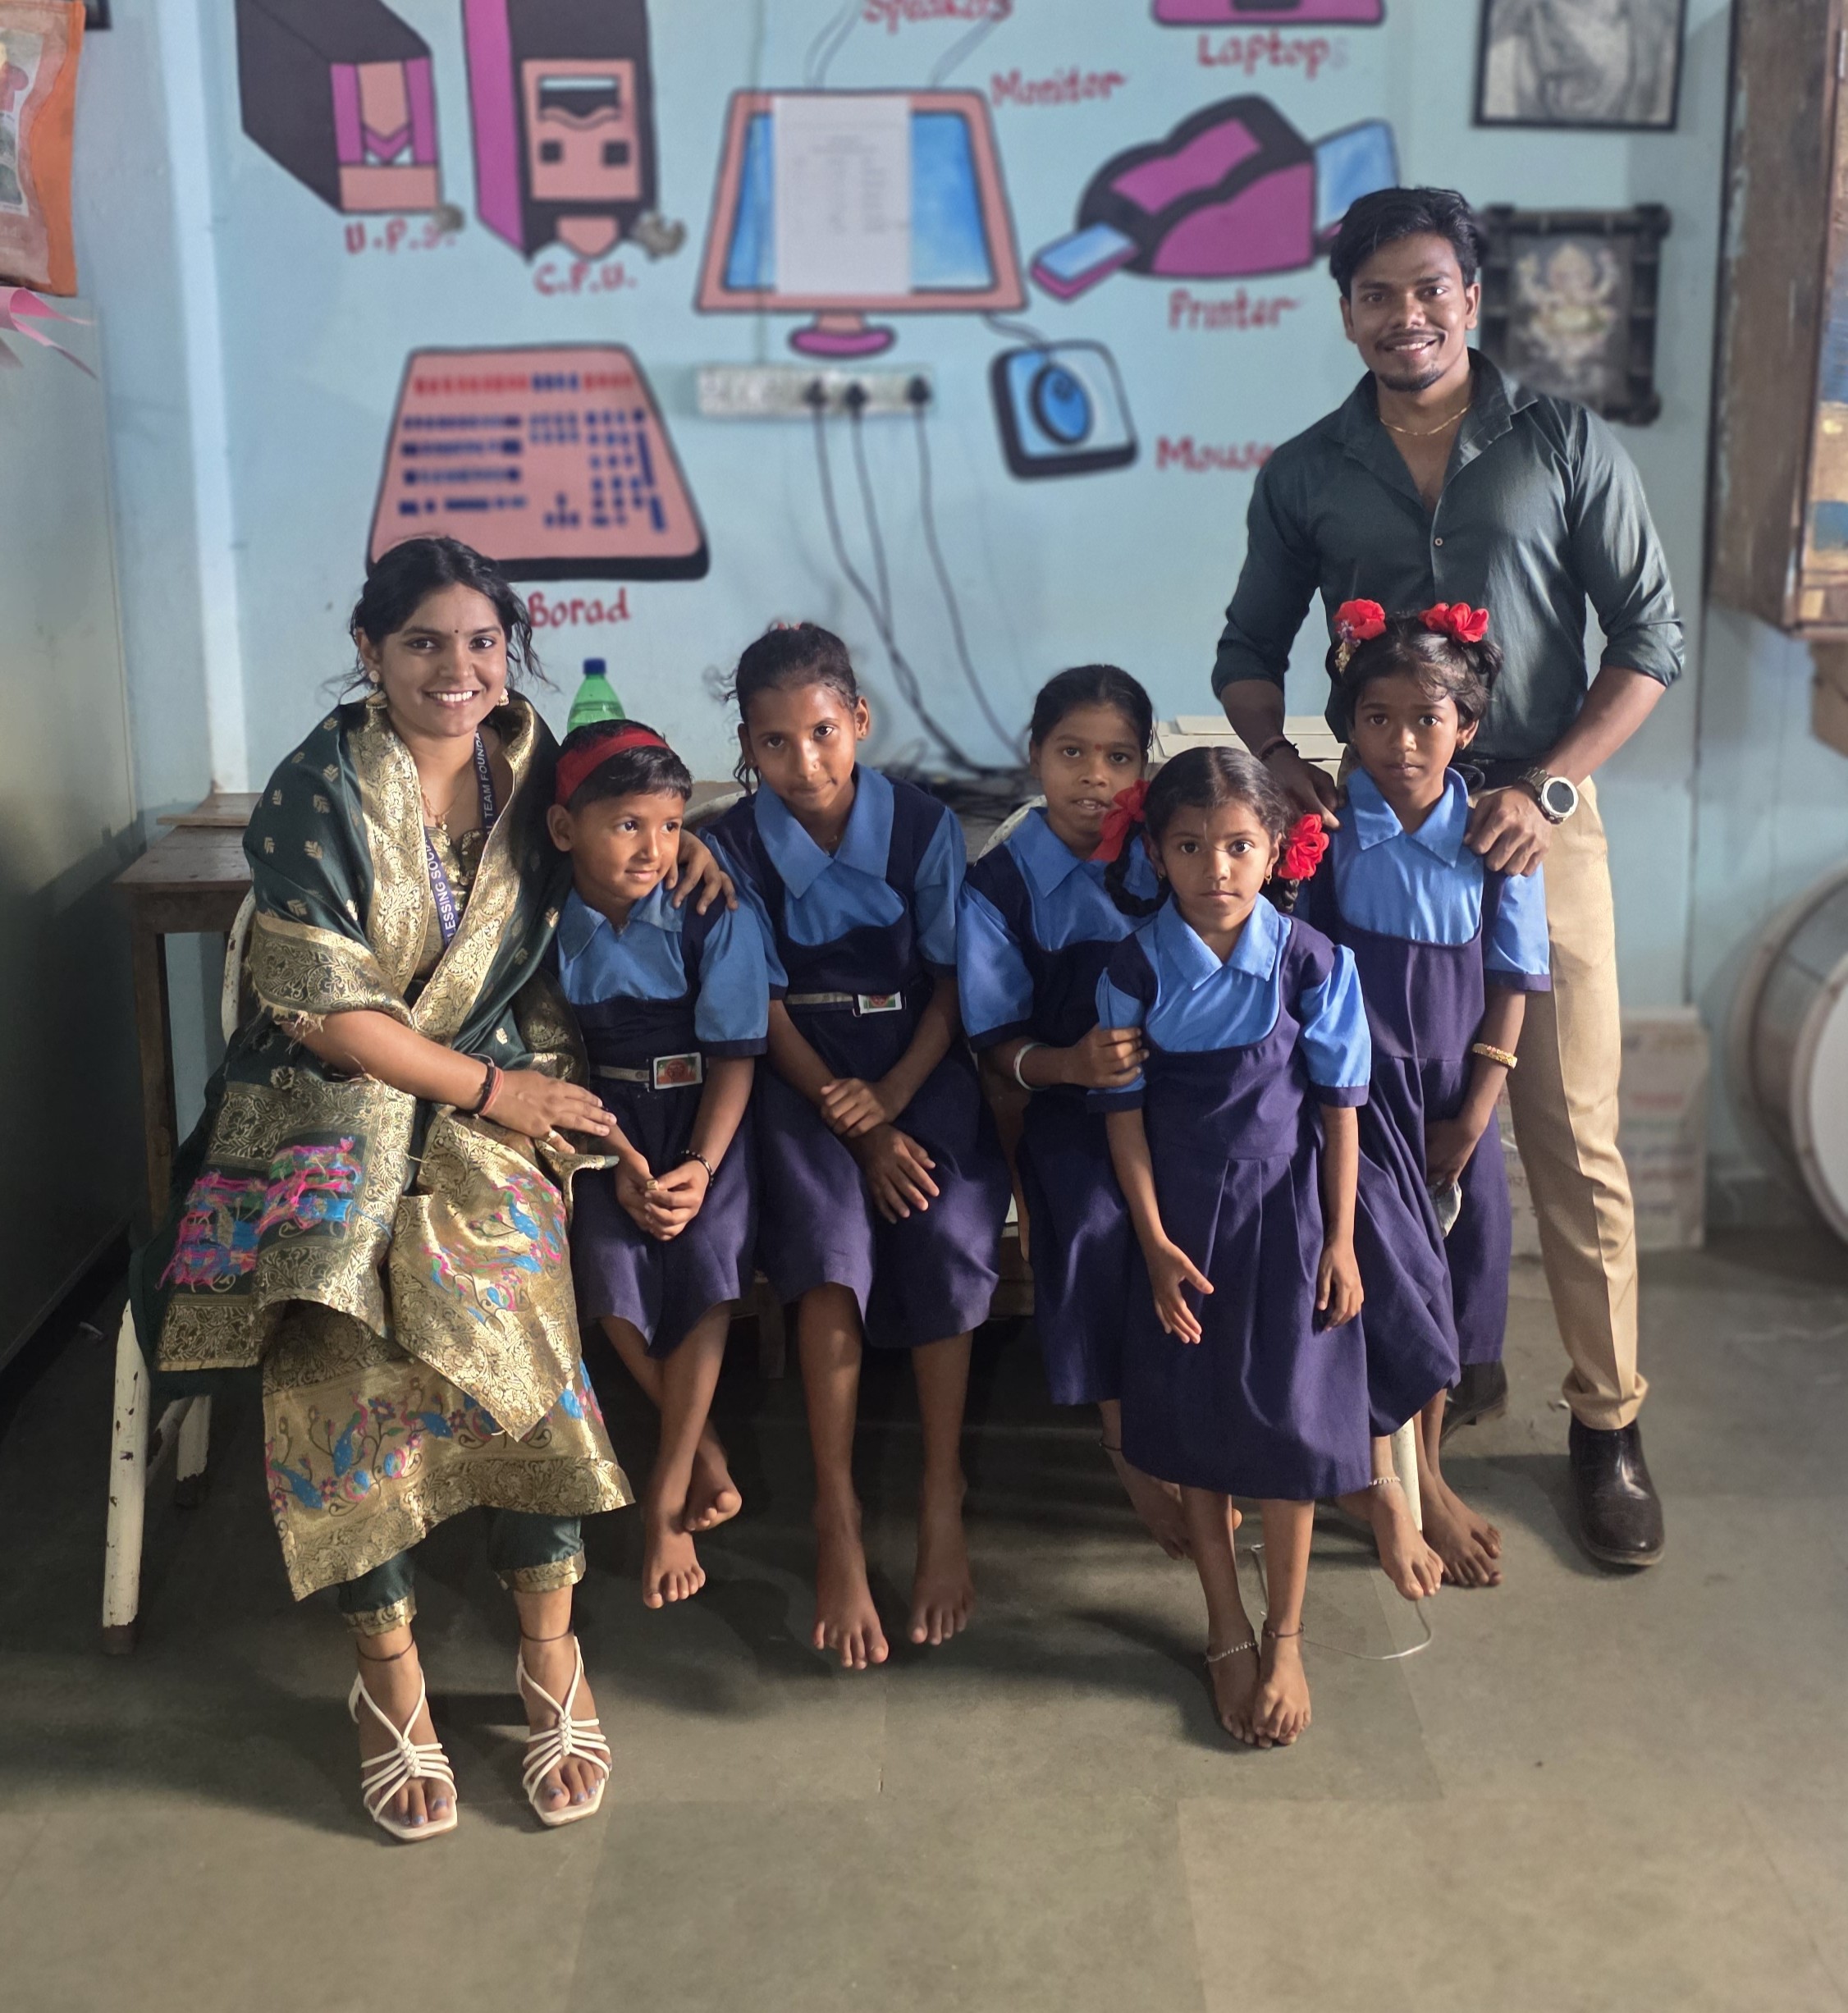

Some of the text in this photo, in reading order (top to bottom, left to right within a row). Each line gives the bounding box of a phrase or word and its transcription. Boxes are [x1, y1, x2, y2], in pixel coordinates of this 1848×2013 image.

[990, 67, 1128, 108] Monitor
[533, 260, 638, 296] C.P.U.
[1168, 287, 1300, 330] Printer
[528, 586, 630, 629] Borad
[483, 784, 494, 819] TEAM
[435, 881, 457, 940] LESSING
